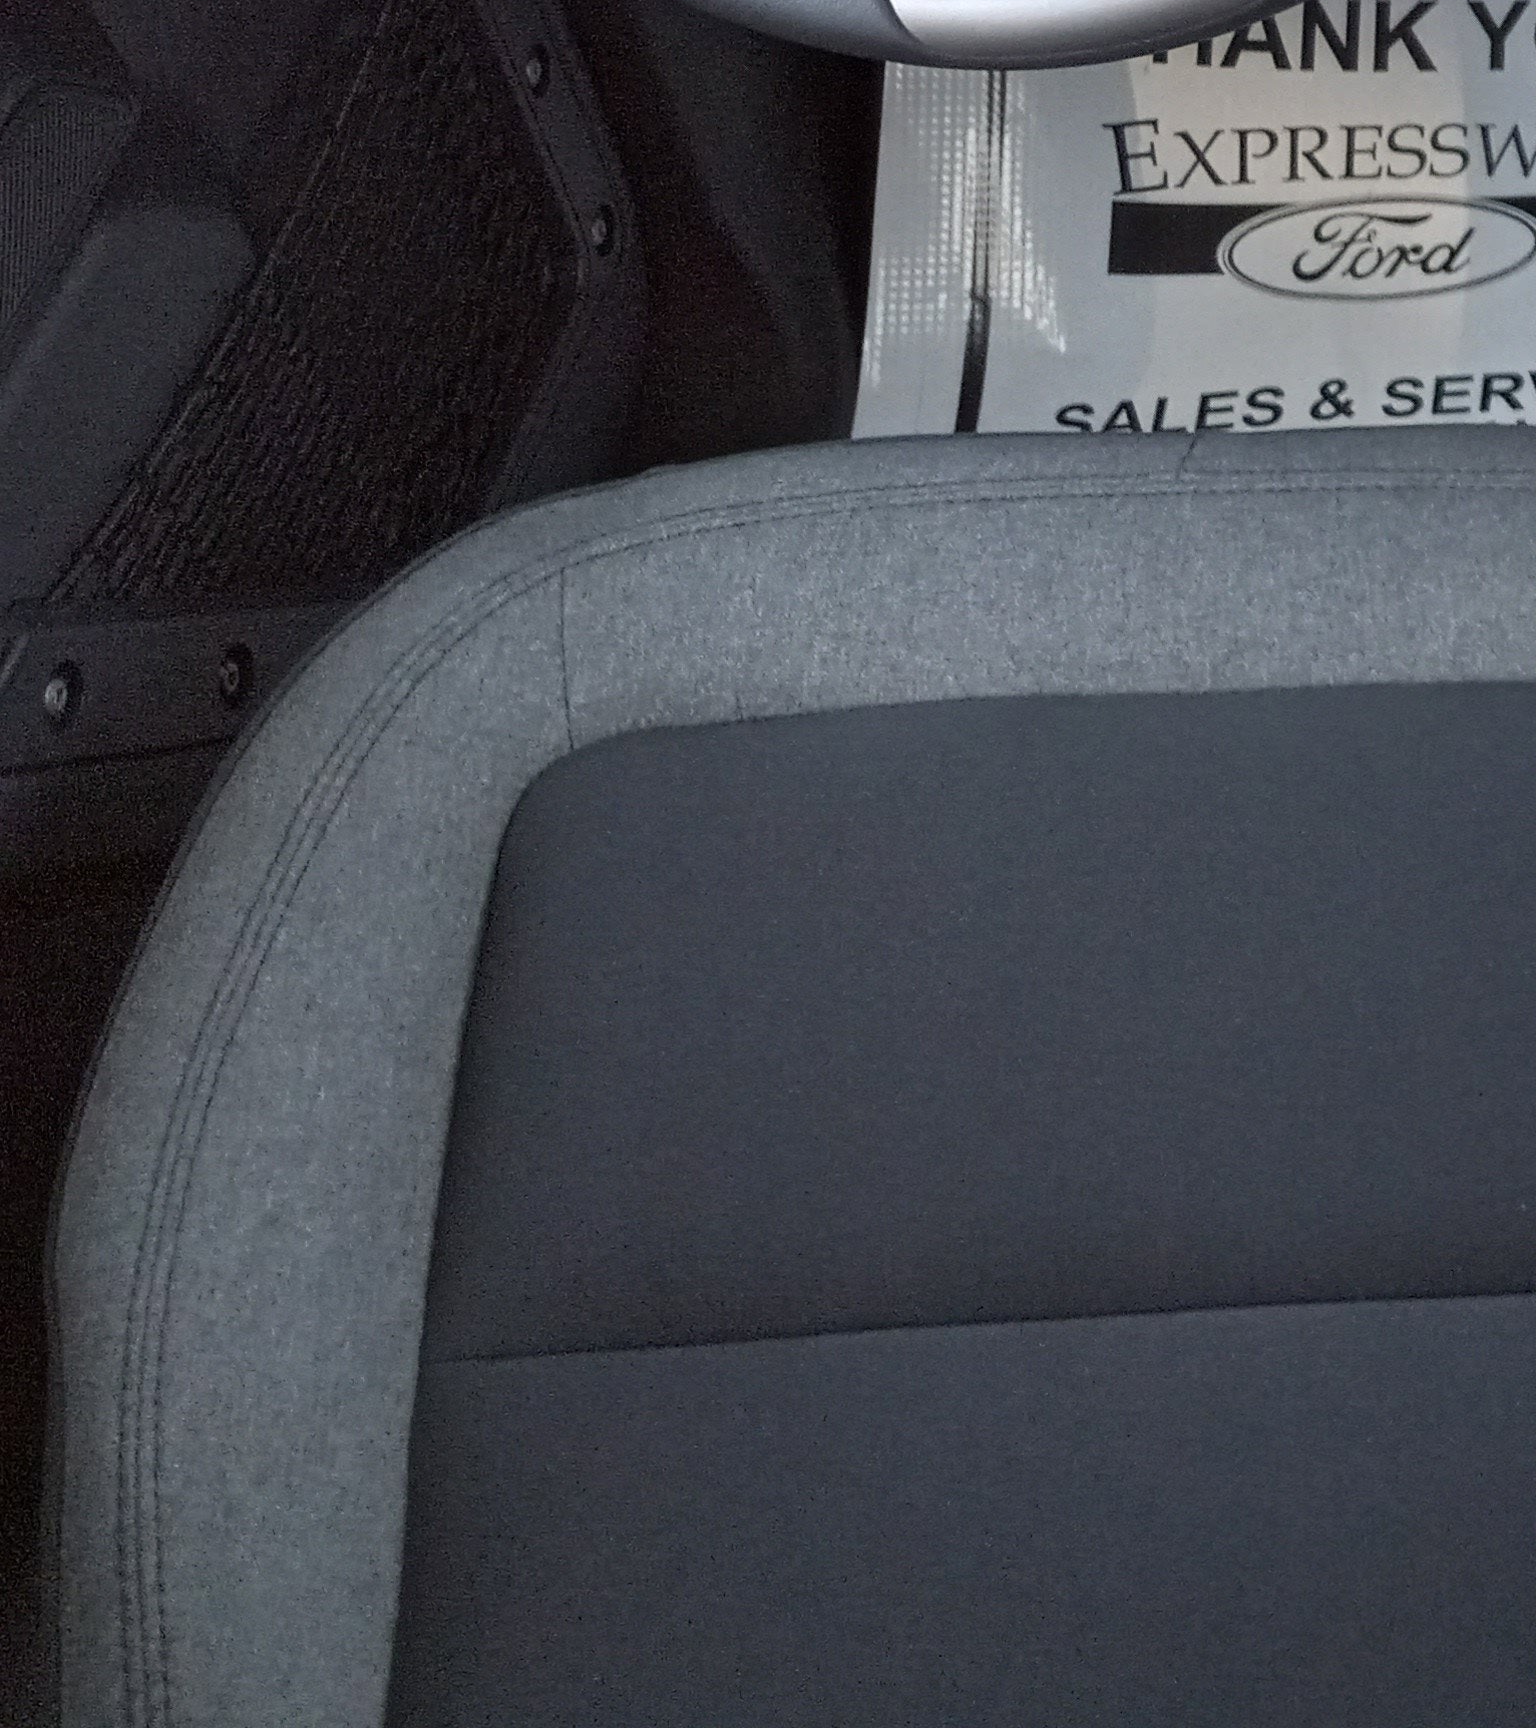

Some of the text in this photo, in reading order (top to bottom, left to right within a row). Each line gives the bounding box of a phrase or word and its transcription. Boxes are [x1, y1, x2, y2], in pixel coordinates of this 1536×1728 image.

[1152, 0, 1439, 73] ANK
[1292, 211, 1476, 281] Ford
[1055, 385, 1285, 434] SALES
[1310, 378, 1354, 421] &
